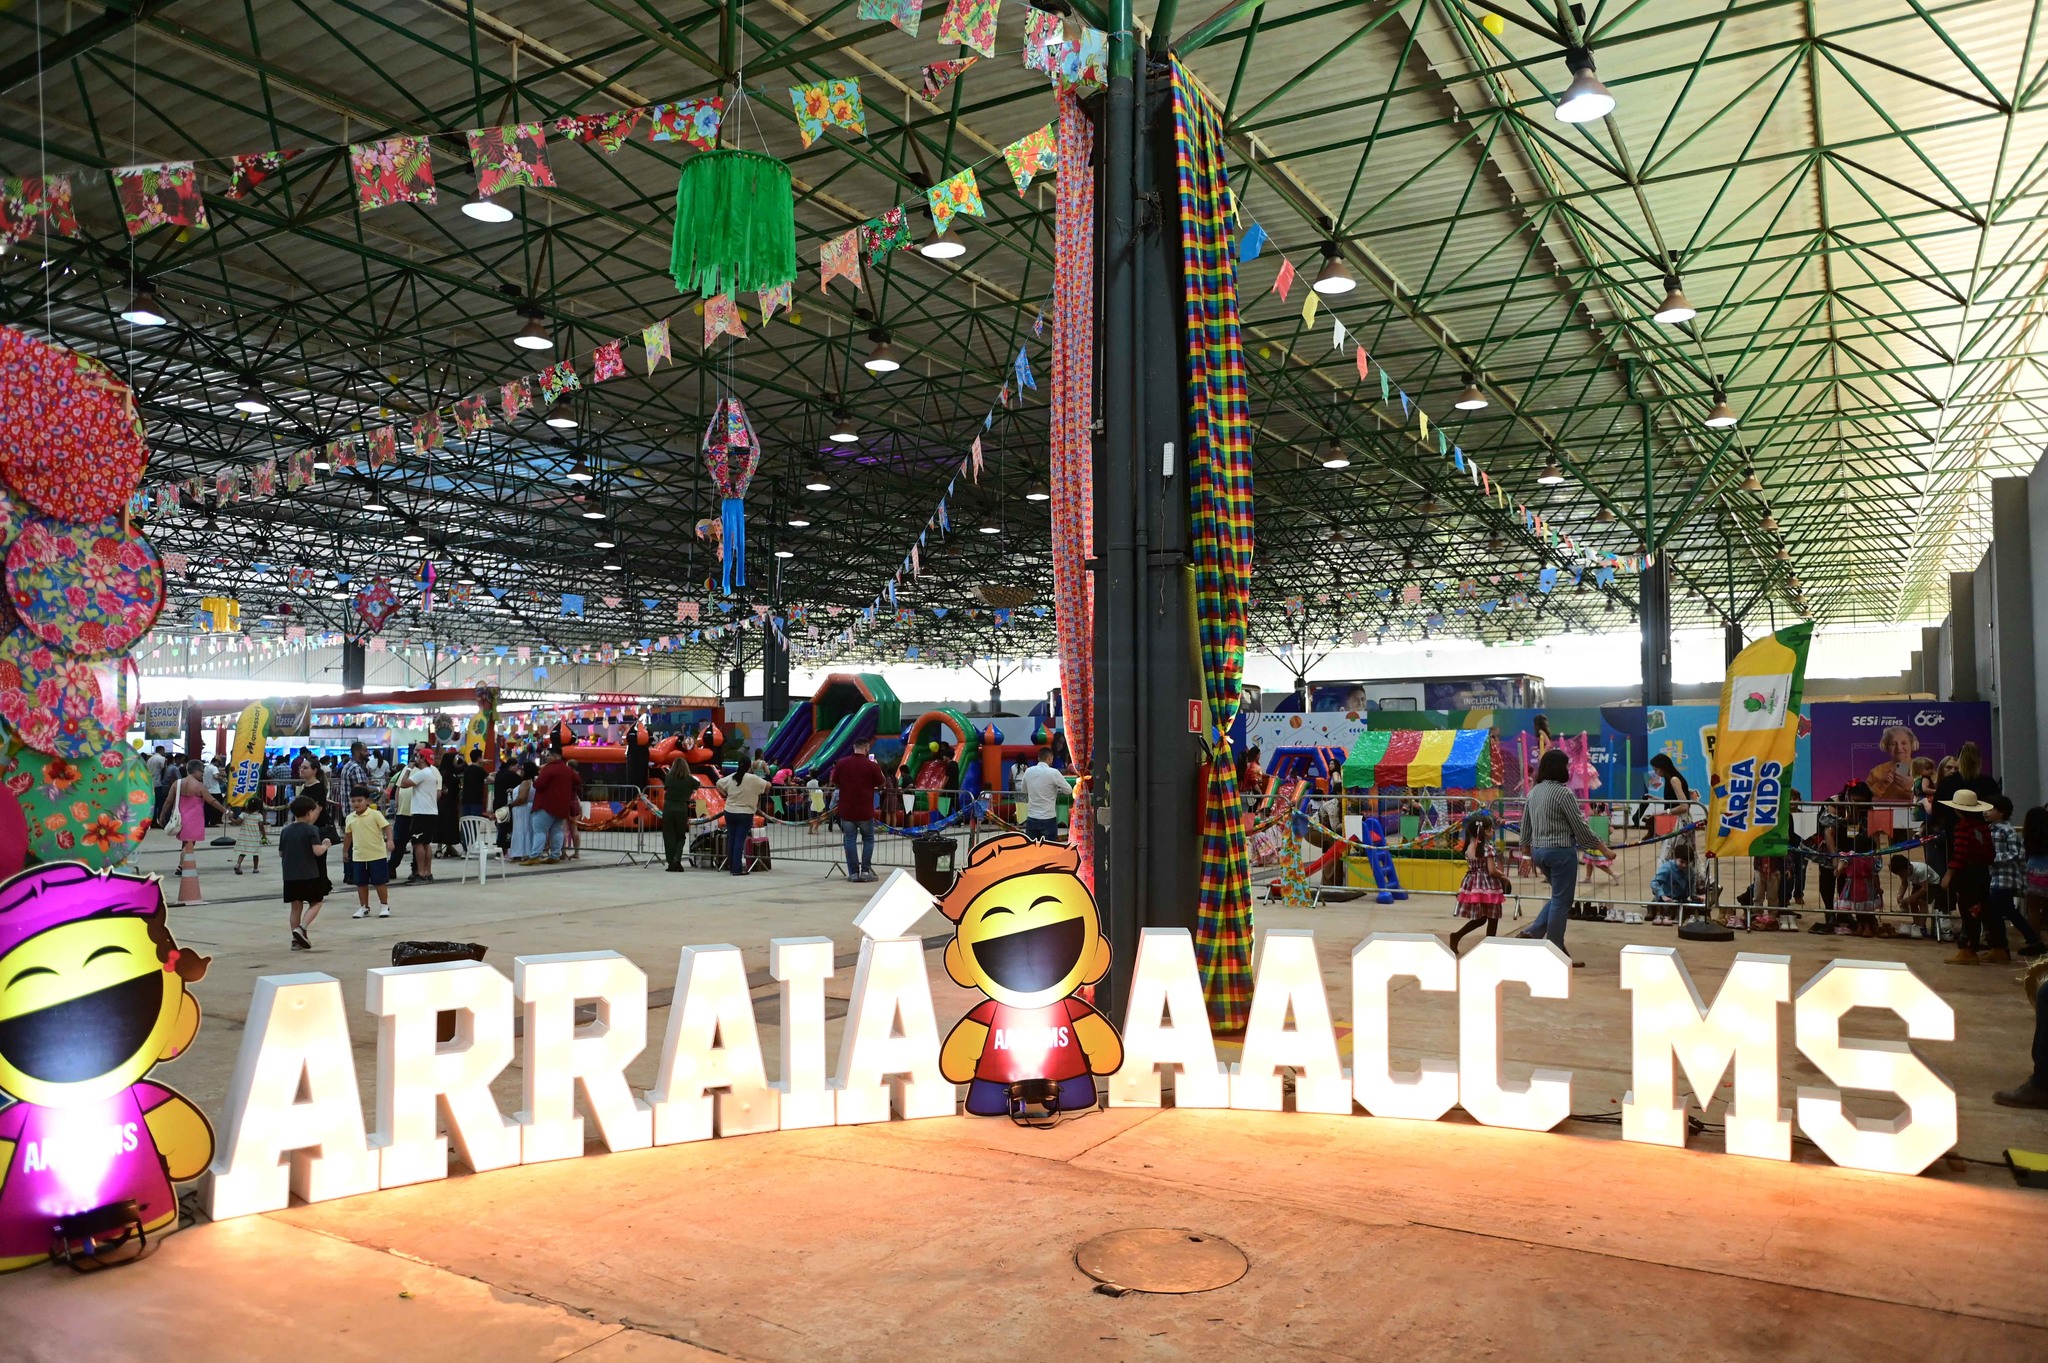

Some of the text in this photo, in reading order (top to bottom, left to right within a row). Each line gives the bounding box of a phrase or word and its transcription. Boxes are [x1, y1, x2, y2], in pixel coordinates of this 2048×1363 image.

[1463, 696, 1500, 705] INCLUSÃO
[235, 760, 250, 794] ÁREA
[248, 762, 260, 792] KIDS
[1722, 758, 1755, 831] ÁREA
[1755, 762, 1781, 825] KIDS
[207, 868, 1959, 1221] ARRAIÁ AACC MS
